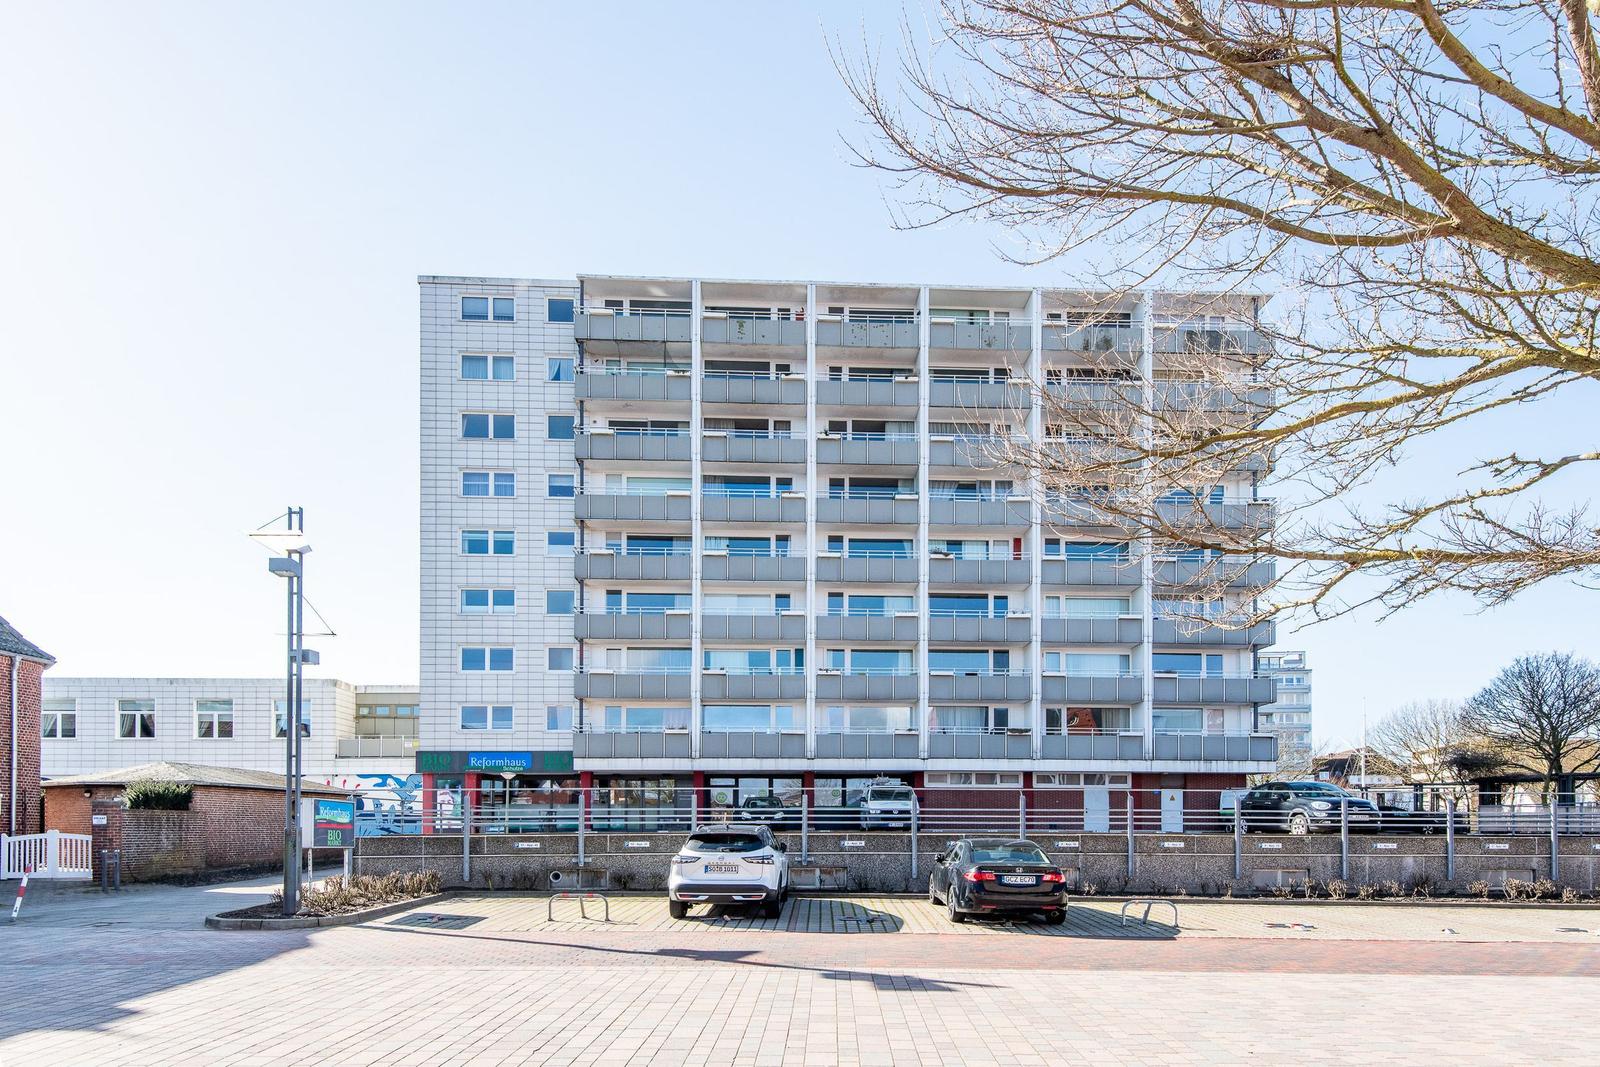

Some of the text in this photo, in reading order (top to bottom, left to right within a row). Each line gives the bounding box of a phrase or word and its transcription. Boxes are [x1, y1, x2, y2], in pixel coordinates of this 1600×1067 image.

[470, 756, 527, 769] Reformhaus
[320, 806, 351, 819] Reformhaus
[327, 830, 342, 841] BIO
